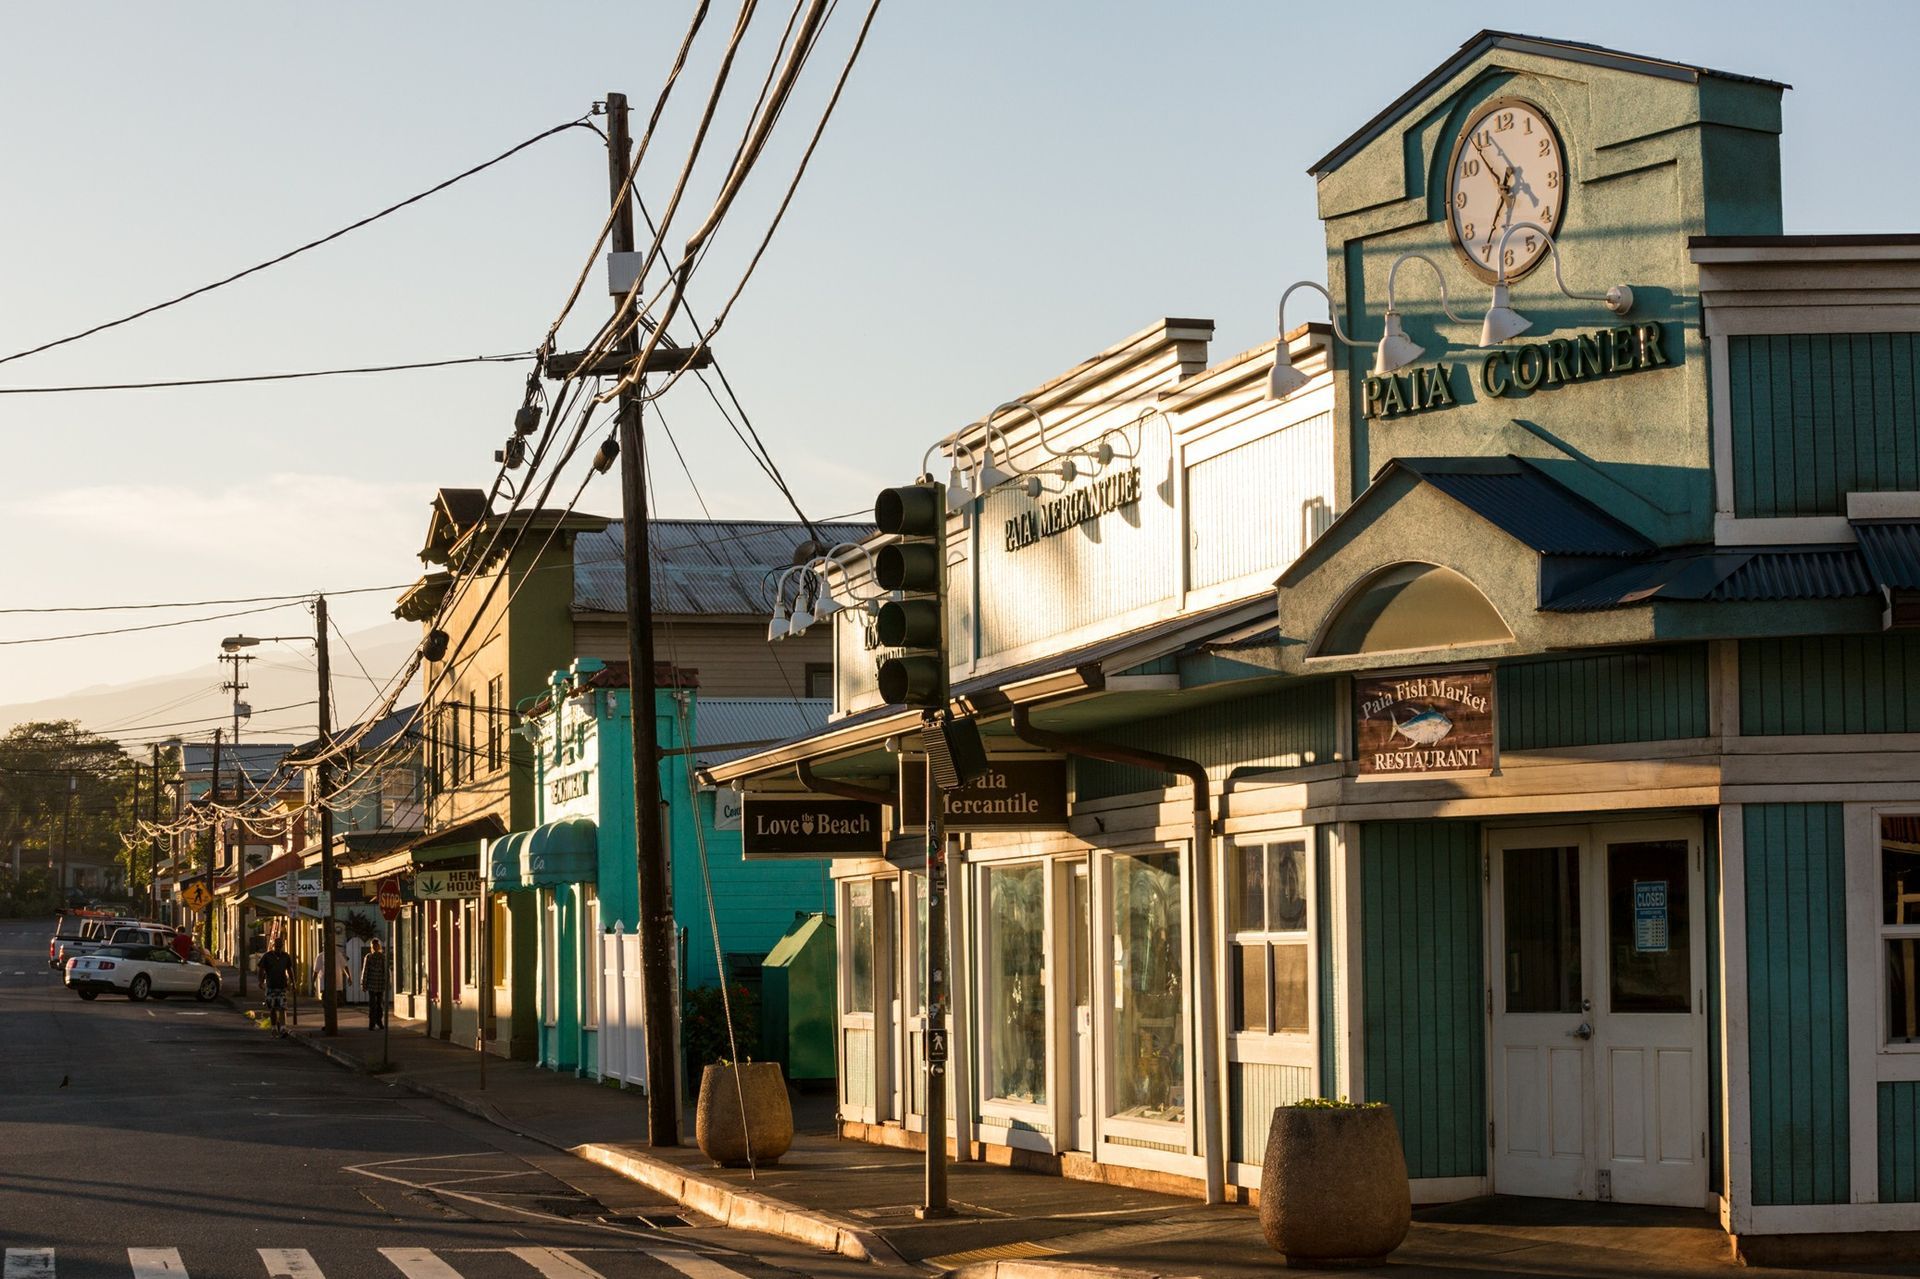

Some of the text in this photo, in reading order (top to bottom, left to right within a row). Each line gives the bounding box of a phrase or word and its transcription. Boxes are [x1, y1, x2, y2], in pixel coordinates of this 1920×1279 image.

[1495, 112, 1514, 133] 12
[1523, 117, 1533, 135] 1
[1476, 130, 1492, 149] 11
[1539, 139, 1550, 157] 2
[1461, 159, 1479, 179] 10
[1548, 171, 1558, 189] 3
[1457, 192, 1467, 209] 9
[1541, 206, 1552, 223] 4
[1464, 223, 1475, 241] 8
[1525, 235, 1537, 253] 5
[1482, 244, 1492, 263] 7
[1504, 249, 1514, 267] 6
[1361, 320, 1667, 419] PAIA CORNER
[1005, 466, 1142, 552] PAIA MERCANTILE
[1361, 679, 1487, 720] Paia Fish Market
[1375, 749, 1479, 770] RESTAURANT
[968, 769, 1007, 789] aia
[757, 813, 870, 835] Love the Beach
[449, 871, 480, 882] HEM
[447, 881, 481, 892] HOUS
[381, 893, 400, 909] STOP
[1637, 893, 1665, 907] CLOSED
